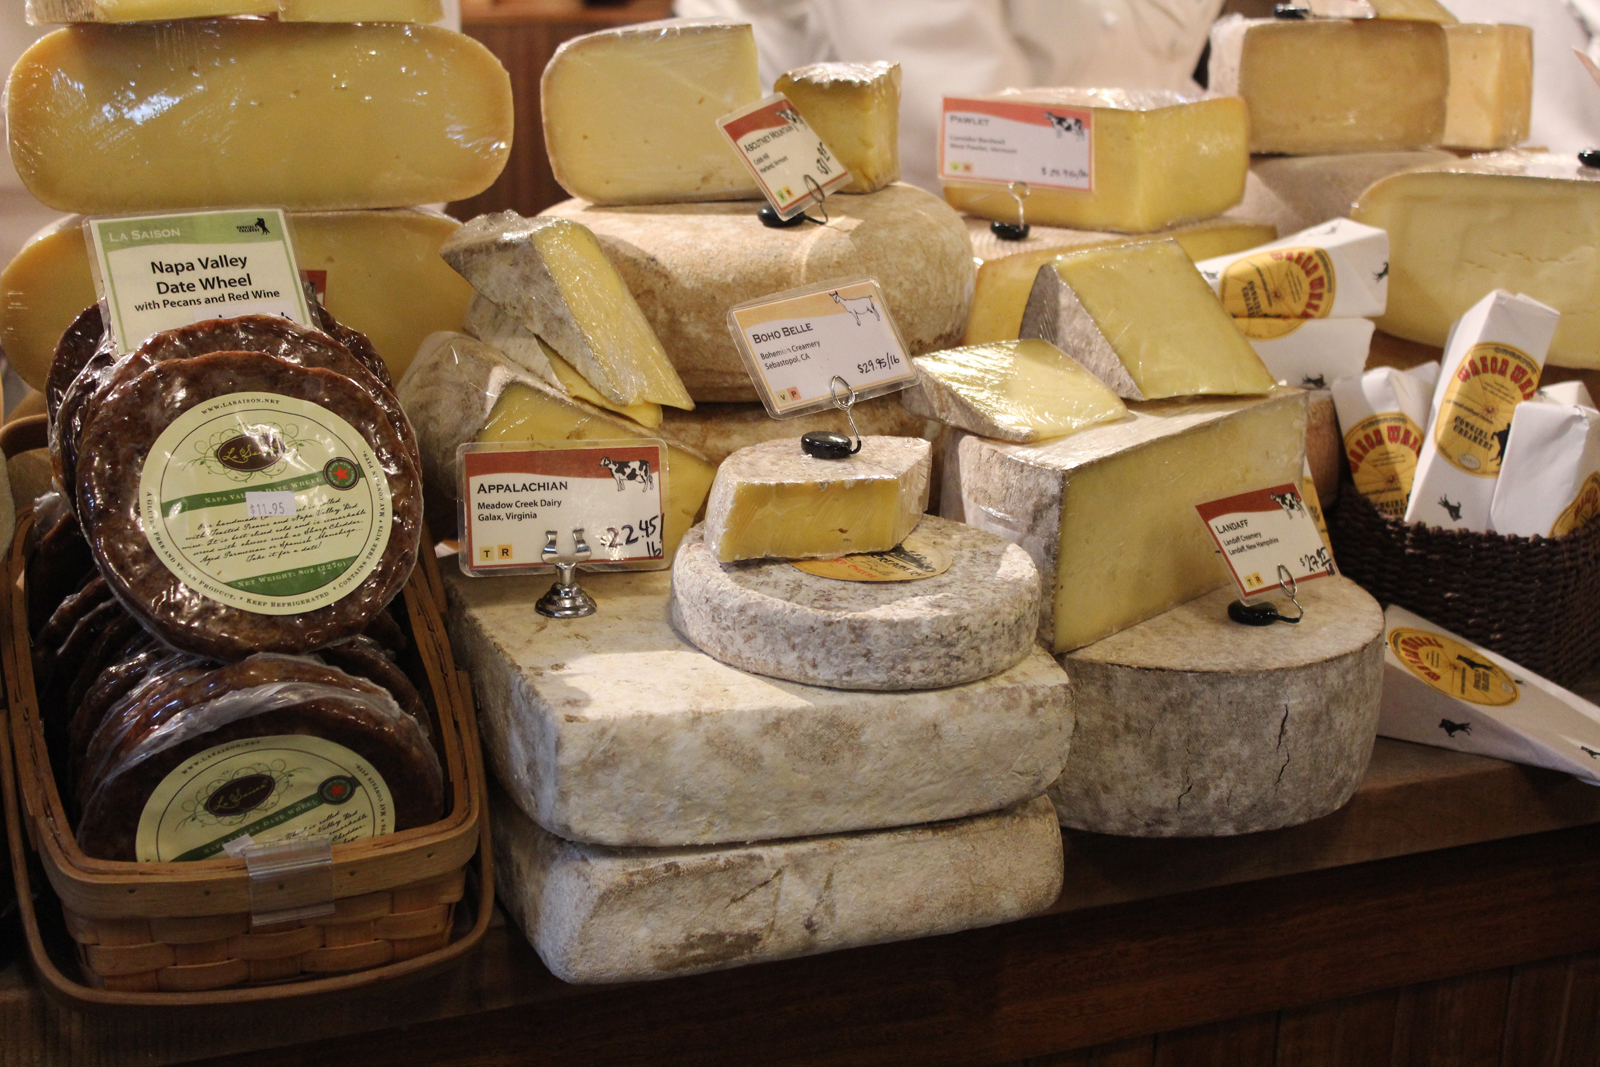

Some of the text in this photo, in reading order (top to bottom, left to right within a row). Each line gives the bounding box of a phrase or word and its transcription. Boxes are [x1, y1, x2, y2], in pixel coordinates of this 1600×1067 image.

[950, 115, 990, 126] PAWLET
[744, 125, 794, 153] ASCUTNEY MOUNTAIN
[109, 228, 181, 243] LA SAISON
[151, 254, 248, 276] Napa Valley
[156, 273, 252, 294] Date Wheel
[135, 288, 280, 312] with Pecans and Red Wine
[752, 323, 814, 344] BOHO BELLE
[760, 340, 820, 360] Bohemian Creamery
[764, 353, 810, 370] Sebastopol, CA
[790, 390, 797, 398] P
[201, 398, 280, 415] WWW.LASAISON.NET
[1454, 416, 1488, 440] COWGIRL
[1453, 424, 1494, 452] CREAMERY
[204, 496, 227, 504] NAPA
[266, 484, 288, 492] DATE
[290, 478, 321, 488] WHEEL
[477, 481, 568, 494] APPALACHIAN
[250, 502, 284, 514] $11.95
[478, 498, 562, 510] Meadow Creek Dairy
[186, 532, 206, 540] with
[211, 527, 240, 536] Toasted
[291, 514, 313, 522] Napa
[343, 503, 358, 511] Red
[216, 516, 258, 526] handmade
[324, 509, 366, 523] remarkable
[478, 512, 538, 522] Galax, Virginia
[1215, 519, 1248, 534] LANDAFF
[218, 542, 236, 552] with
[304, 526, 328, 536] Sharp
[1223, 532, 1262, 546] Landaff Creamery
[1246, 543, 1257, 551] New
[1256, 537, 1280, 548] Hampshire
[200, 555, 220, 566] Aged
[223, 548, 266, 559] Parmesan
[280, 536, 312, 549] Spanish
[246, 554, 266, 562] Take
[278, 550, 290, 559] for
[484, 548, 510, 558] T R
[154, 532, 166, 550] FREE
[164, 550, 176, 562] AND
[176, 562, 198, 582] VEGAN
[246, 599, 268, 608] KEEP
[271, 591, 329, 608] REFRIGERATED
[338, 561, 367, 588] CONTAINS
[366, 543, 378, 560] TREE
[375, 524, 384, 542] NUTS
[238, 580, 256, 588] NET
[258, 572, 296, 583] WEIGHT:
[1256, 576, 1262, 584] R
